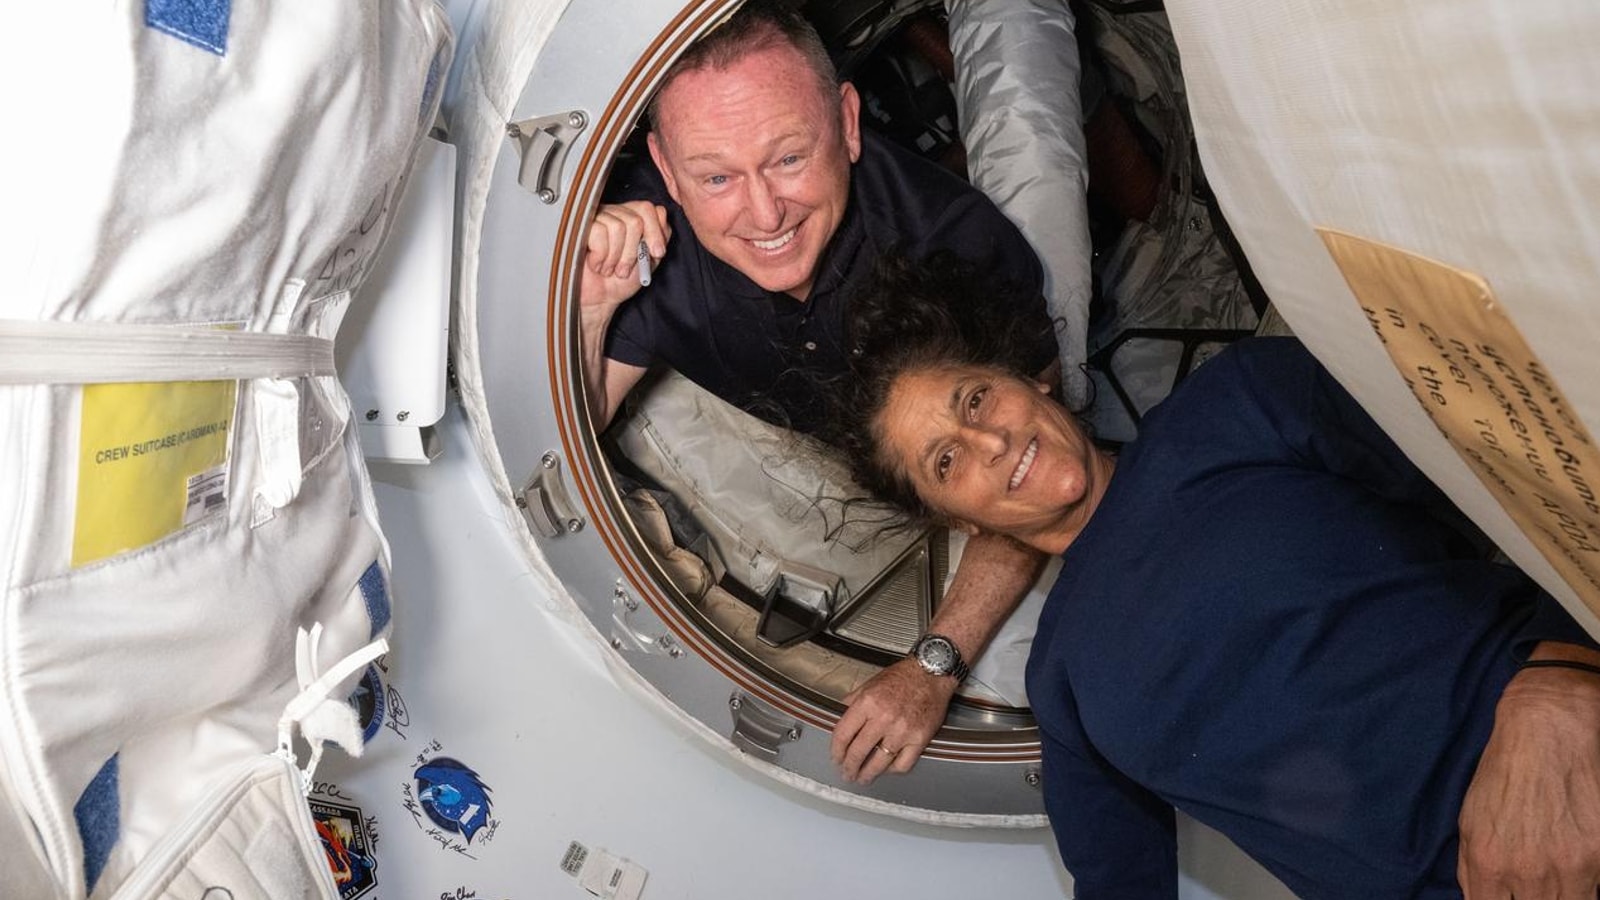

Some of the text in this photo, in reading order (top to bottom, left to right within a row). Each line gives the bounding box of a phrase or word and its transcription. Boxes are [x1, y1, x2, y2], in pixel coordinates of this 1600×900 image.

[1384, 307, 1405, 329] in
[1417, 365, 1447, 405] the
[1418, 322, 1473, 393] cover
[95, 445, 130, 464] CREW
[132, 433, 177, 456] SUITCASE
